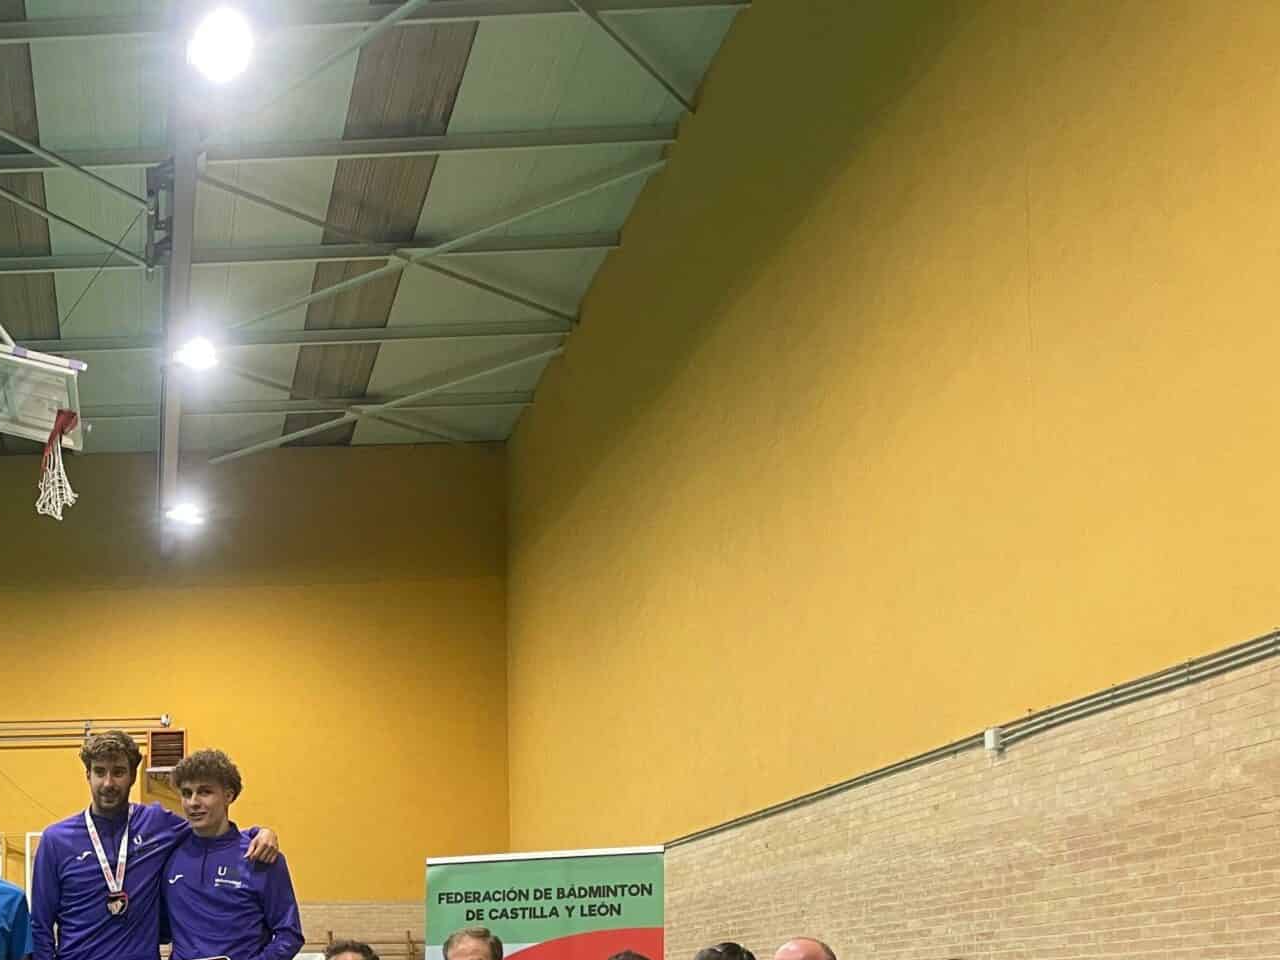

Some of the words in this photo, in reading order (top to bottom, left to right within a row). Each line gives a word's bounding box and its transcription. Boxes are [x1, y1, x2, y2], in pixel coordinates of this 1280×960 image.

[437, 887, 530, 905] FEDERACIÓN
[533, 888, 553, 901] DE
[556, 882, 653, 899] BÁDMINTON
[465, 908, 485, 922] DE
[488, 906, 560, 920] CASTILLA
[564, 905, 576, 918] Y
[580, 902, 622, 918] LEÓN
